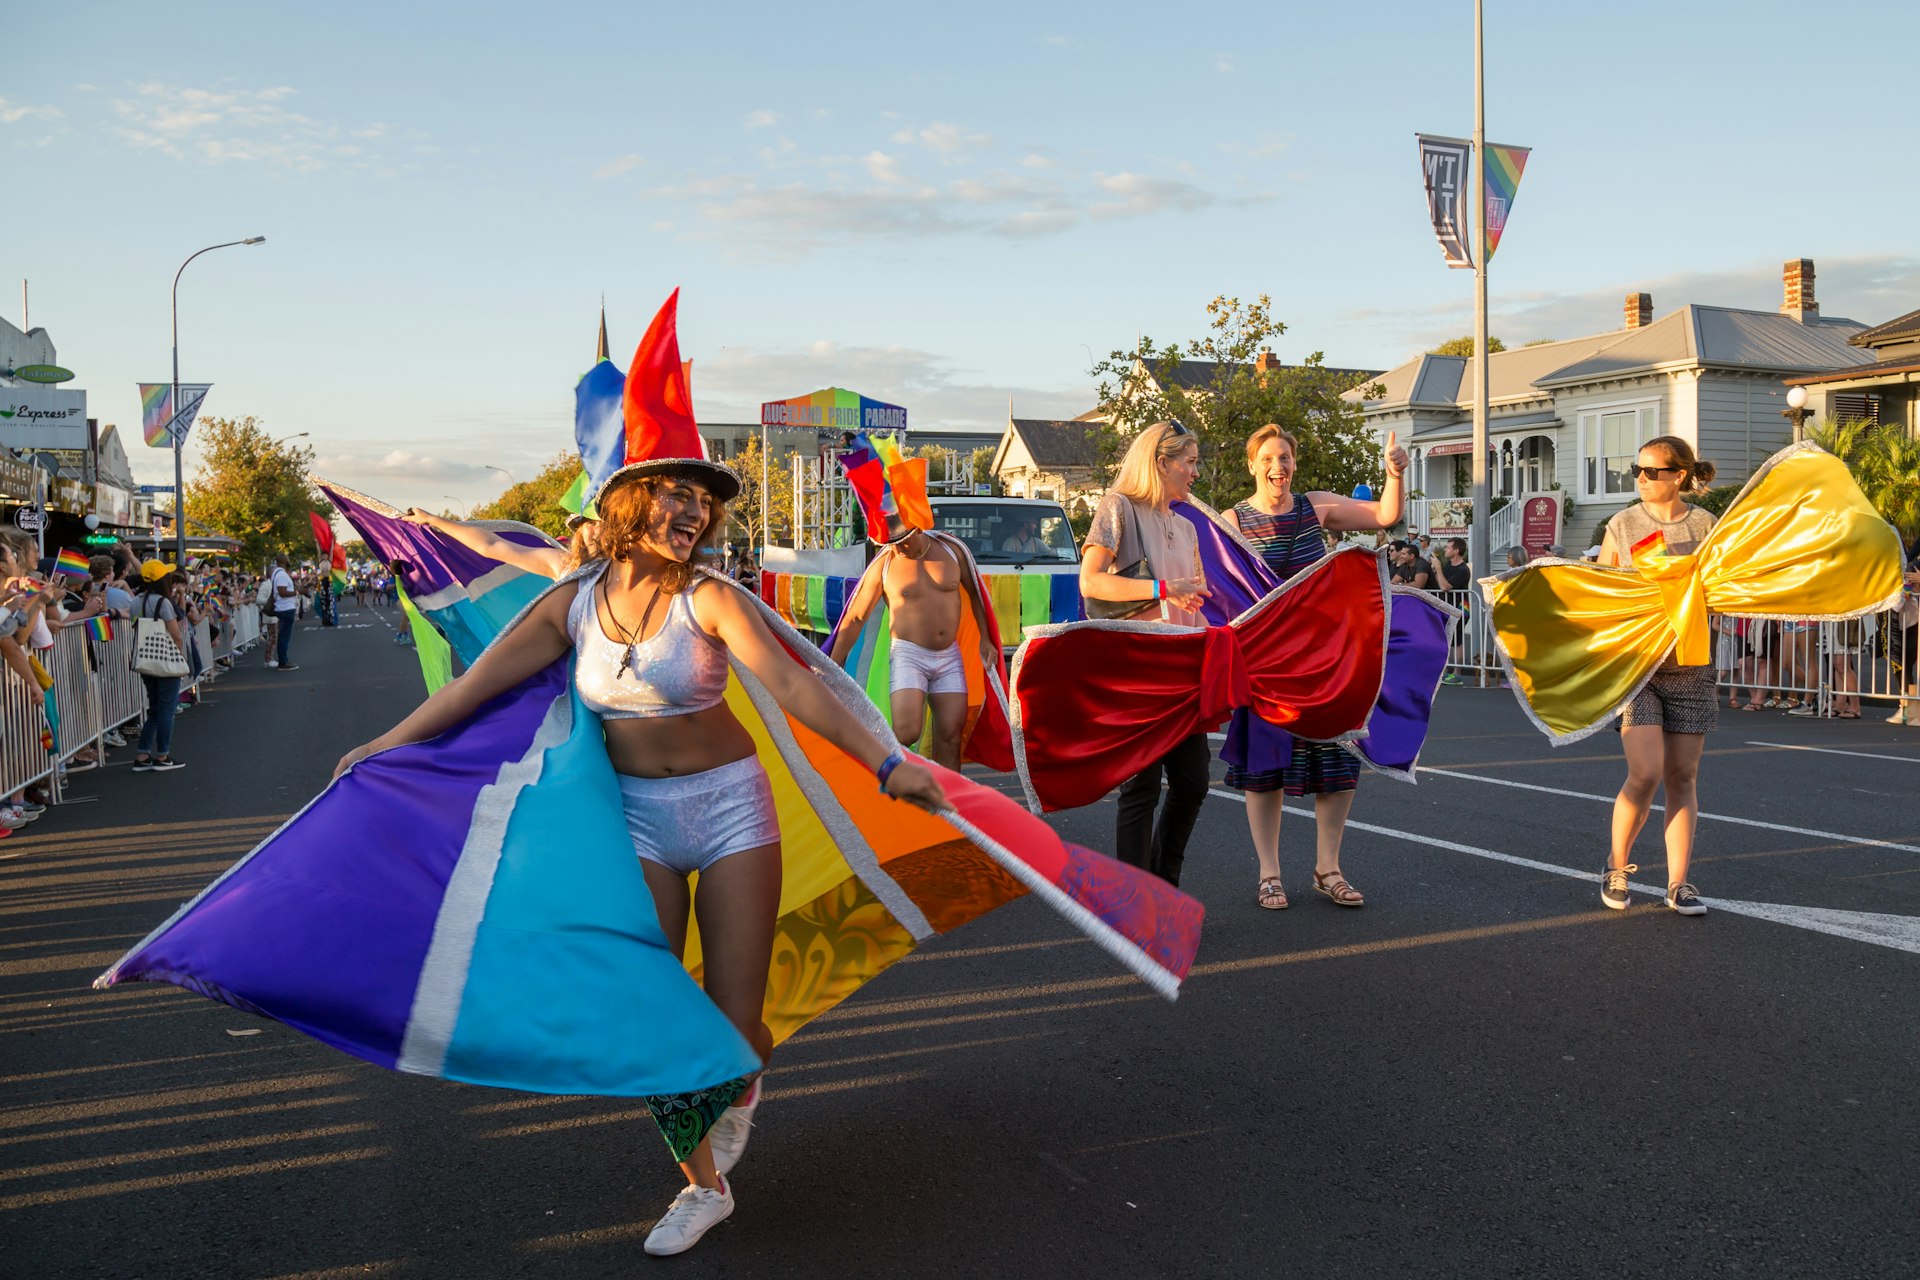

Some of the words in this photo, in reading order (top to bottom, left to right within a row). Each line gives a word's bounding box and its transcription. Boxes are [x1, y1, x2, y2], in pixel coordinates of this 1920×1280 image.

[16, 405, 66, 422] Express
[764, 404, 822, 424] AUCKLAND
[828, 406, 859, 426] PRIDE
[864, 408, 906, 427] PARADE
[0, 460, 30, 482] ROCKET
[2, 480, 28, 495] KITCHEN
